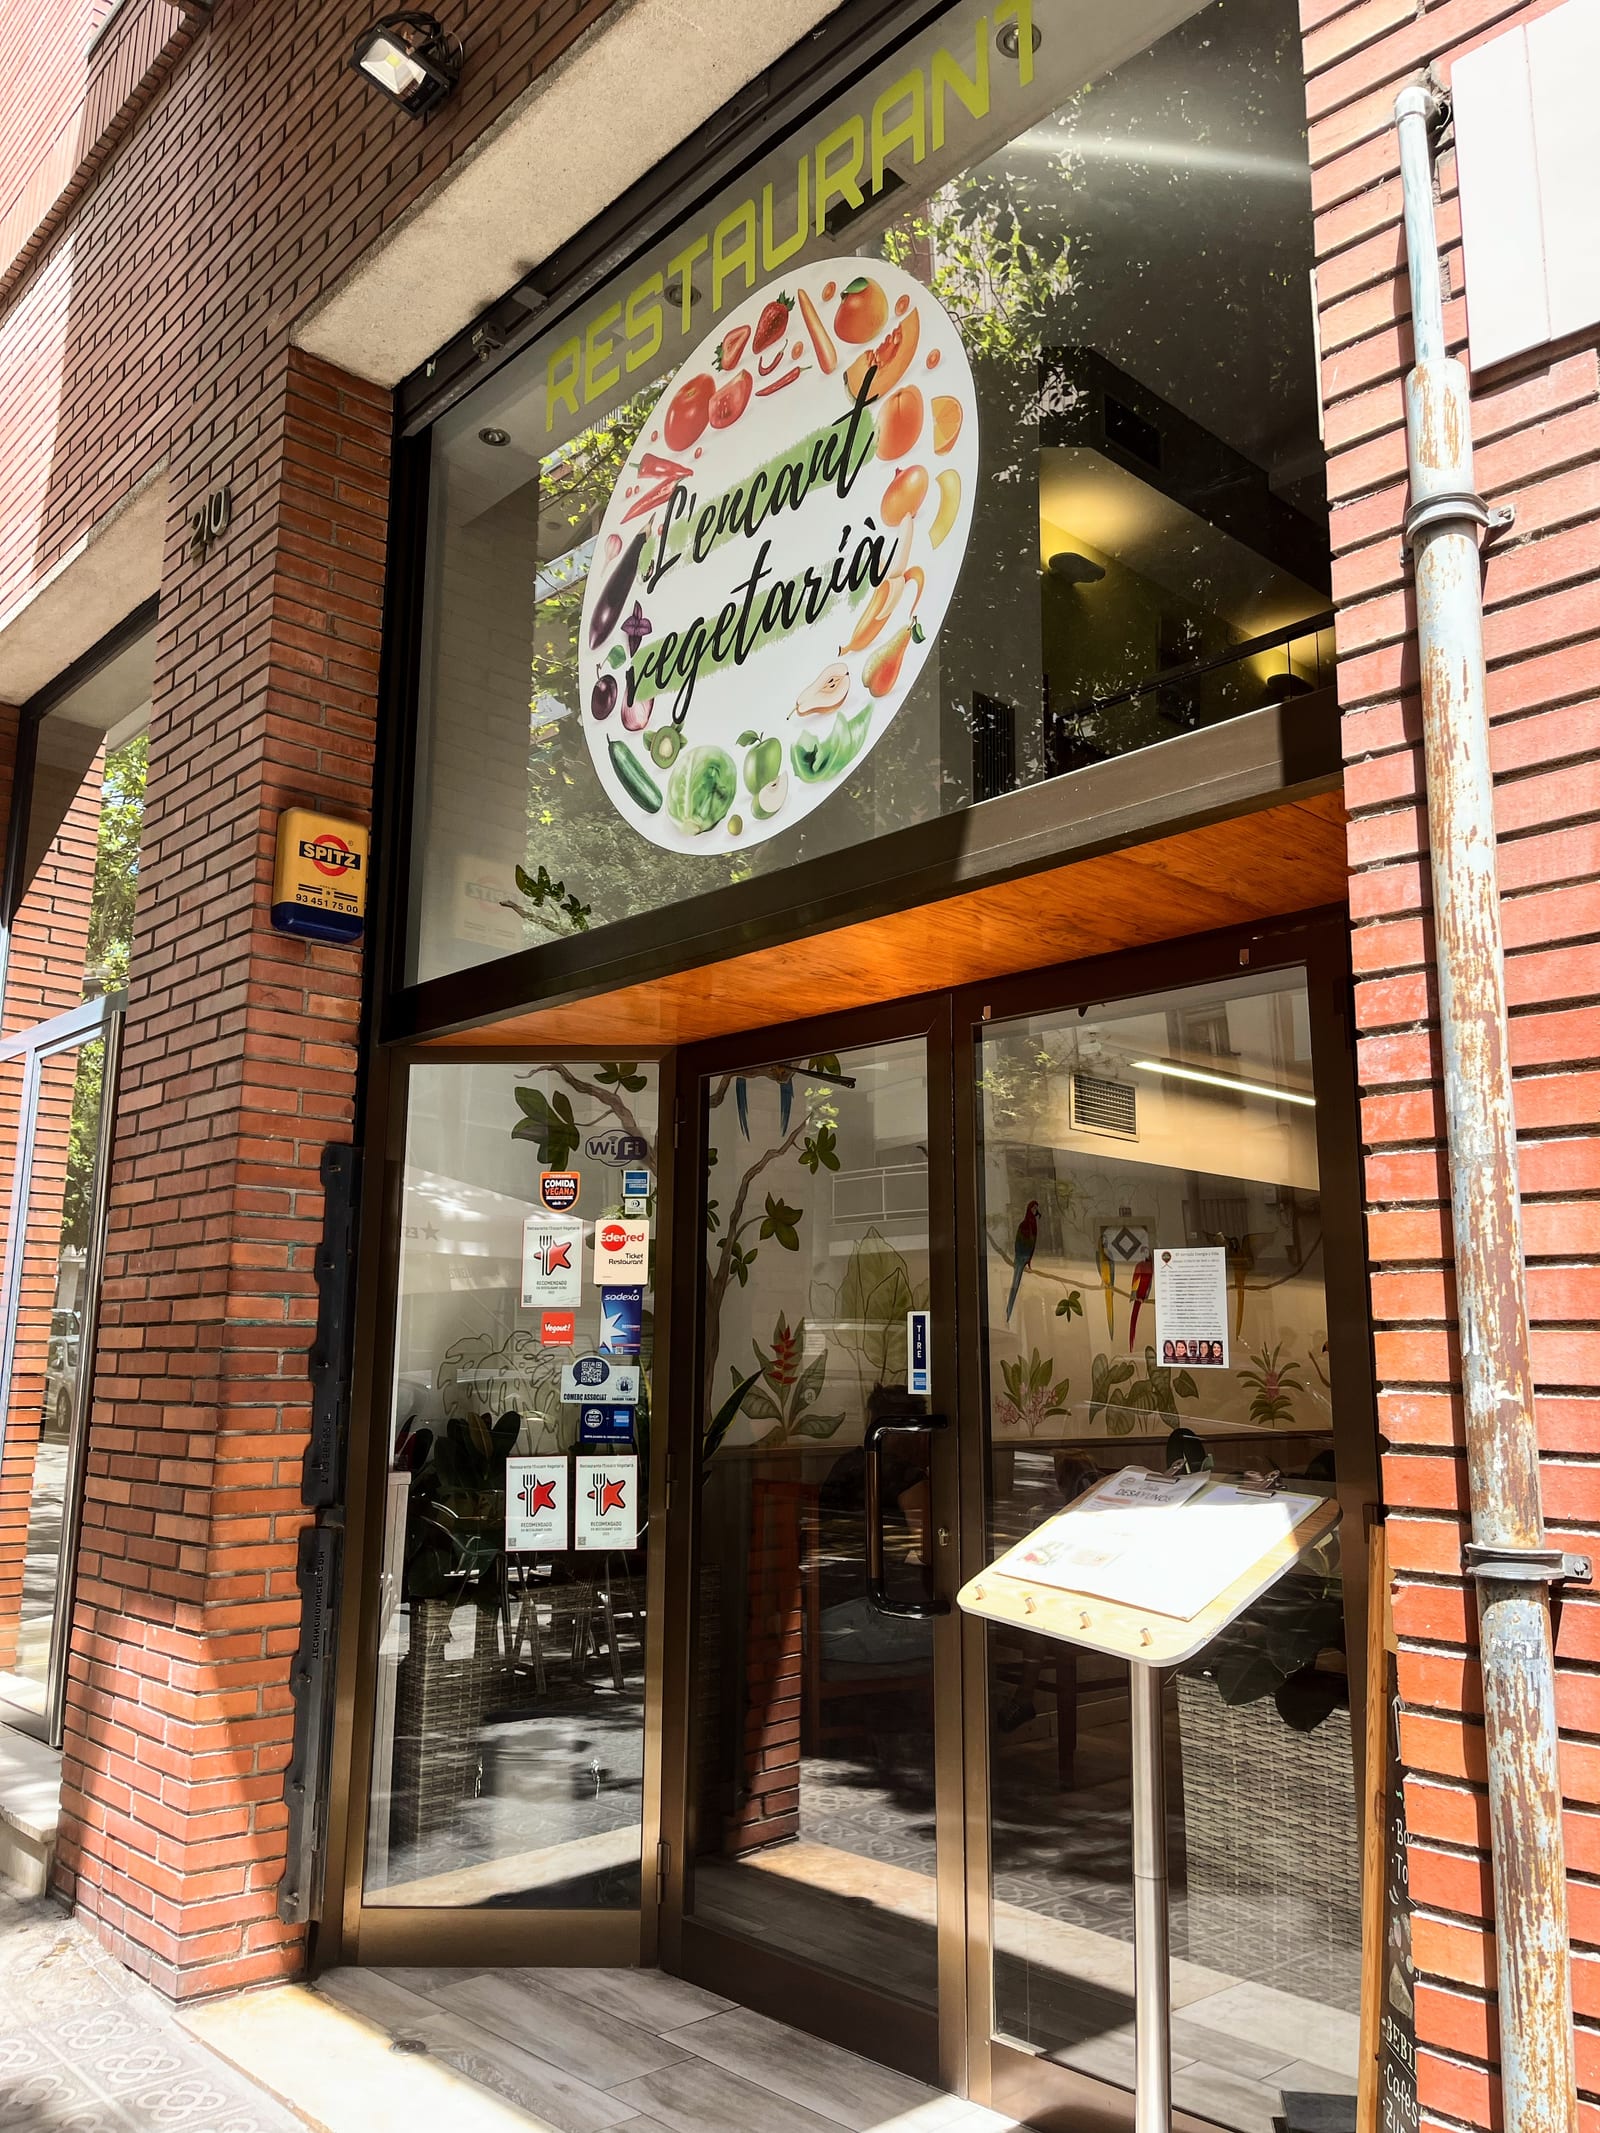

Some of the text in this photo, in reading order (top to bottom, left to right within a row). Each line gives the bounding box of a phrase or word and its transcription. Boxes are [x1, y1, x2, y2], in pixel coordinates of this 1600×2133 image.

[545, 0, 1035, 432] RESTAURANT
[643, 365, 879, 594] L'encant
[626, 517, 899, 724] vegetarià
[303, 843, 356, 868] SPITZ
[296, 893, 358, 914] 93 451 75 00
[544, 1179, 575, 1189] COMIDA
[544, 1187, 575, 1196] VEGANA
[601, 1231, 645, 1242] Edenred
[604, 1291, 640, 1301] sodexo
[1386, 2015, 1417, 2079] BEBI
